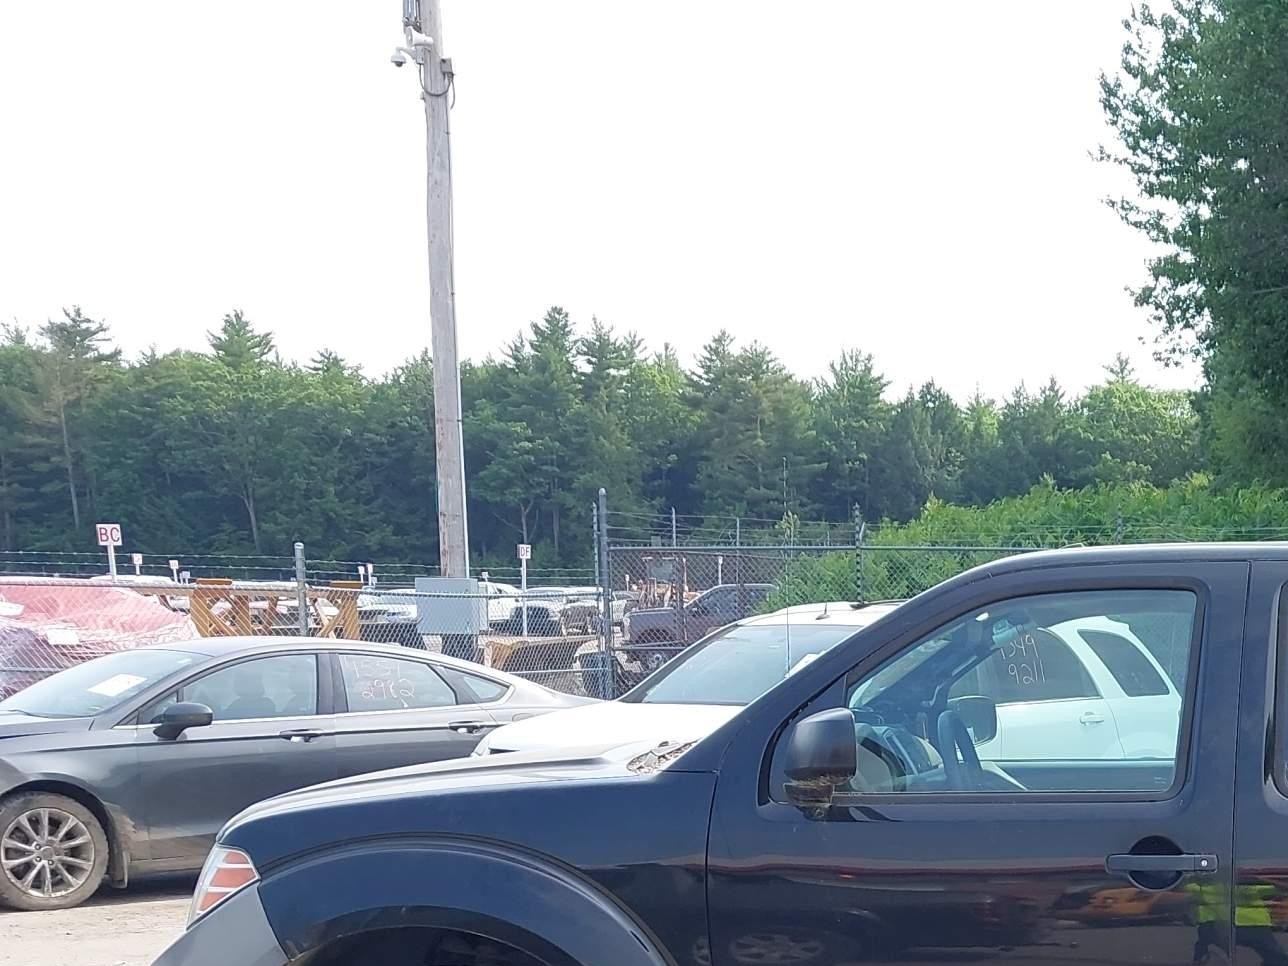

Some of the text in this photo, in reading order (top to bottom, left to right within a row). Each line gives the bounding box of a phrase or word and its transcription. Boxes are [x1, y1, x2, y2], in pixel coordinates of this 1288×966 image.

[98, 527, 120, 543] BC
[521, 547, 529, 556] DF
[1008, 659, 1046, 686] 9211
